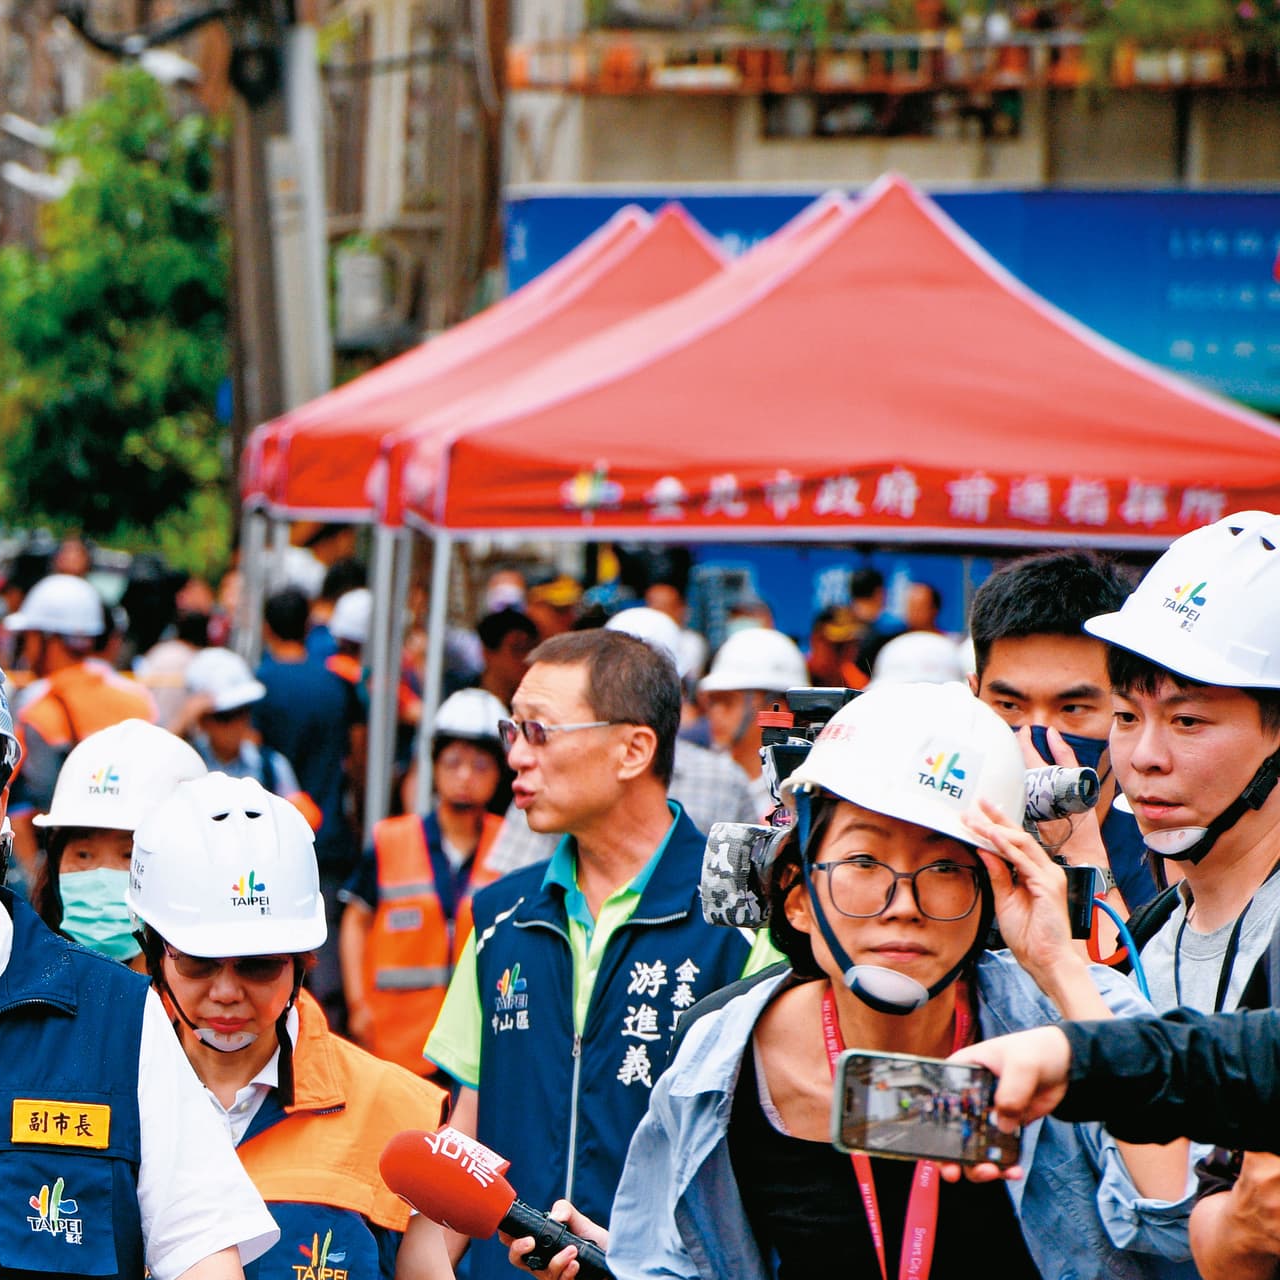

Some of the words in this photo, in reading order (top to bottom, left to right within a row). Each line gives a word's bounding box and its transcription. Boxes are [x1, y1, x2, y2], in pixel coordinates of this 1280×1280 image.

[1162, 597, 1201, 622] TAIPEI
[230, 896, 270, 907] TAIPEI
[616, 959, 668, 1089] 游進義
[28, 1111, 94, 1138] 副市長
[27, 1216, 83, 1235] TAIPEI
[912, 1227, 927, 1256] Smart
[908, 1257, 922, 1275] City
